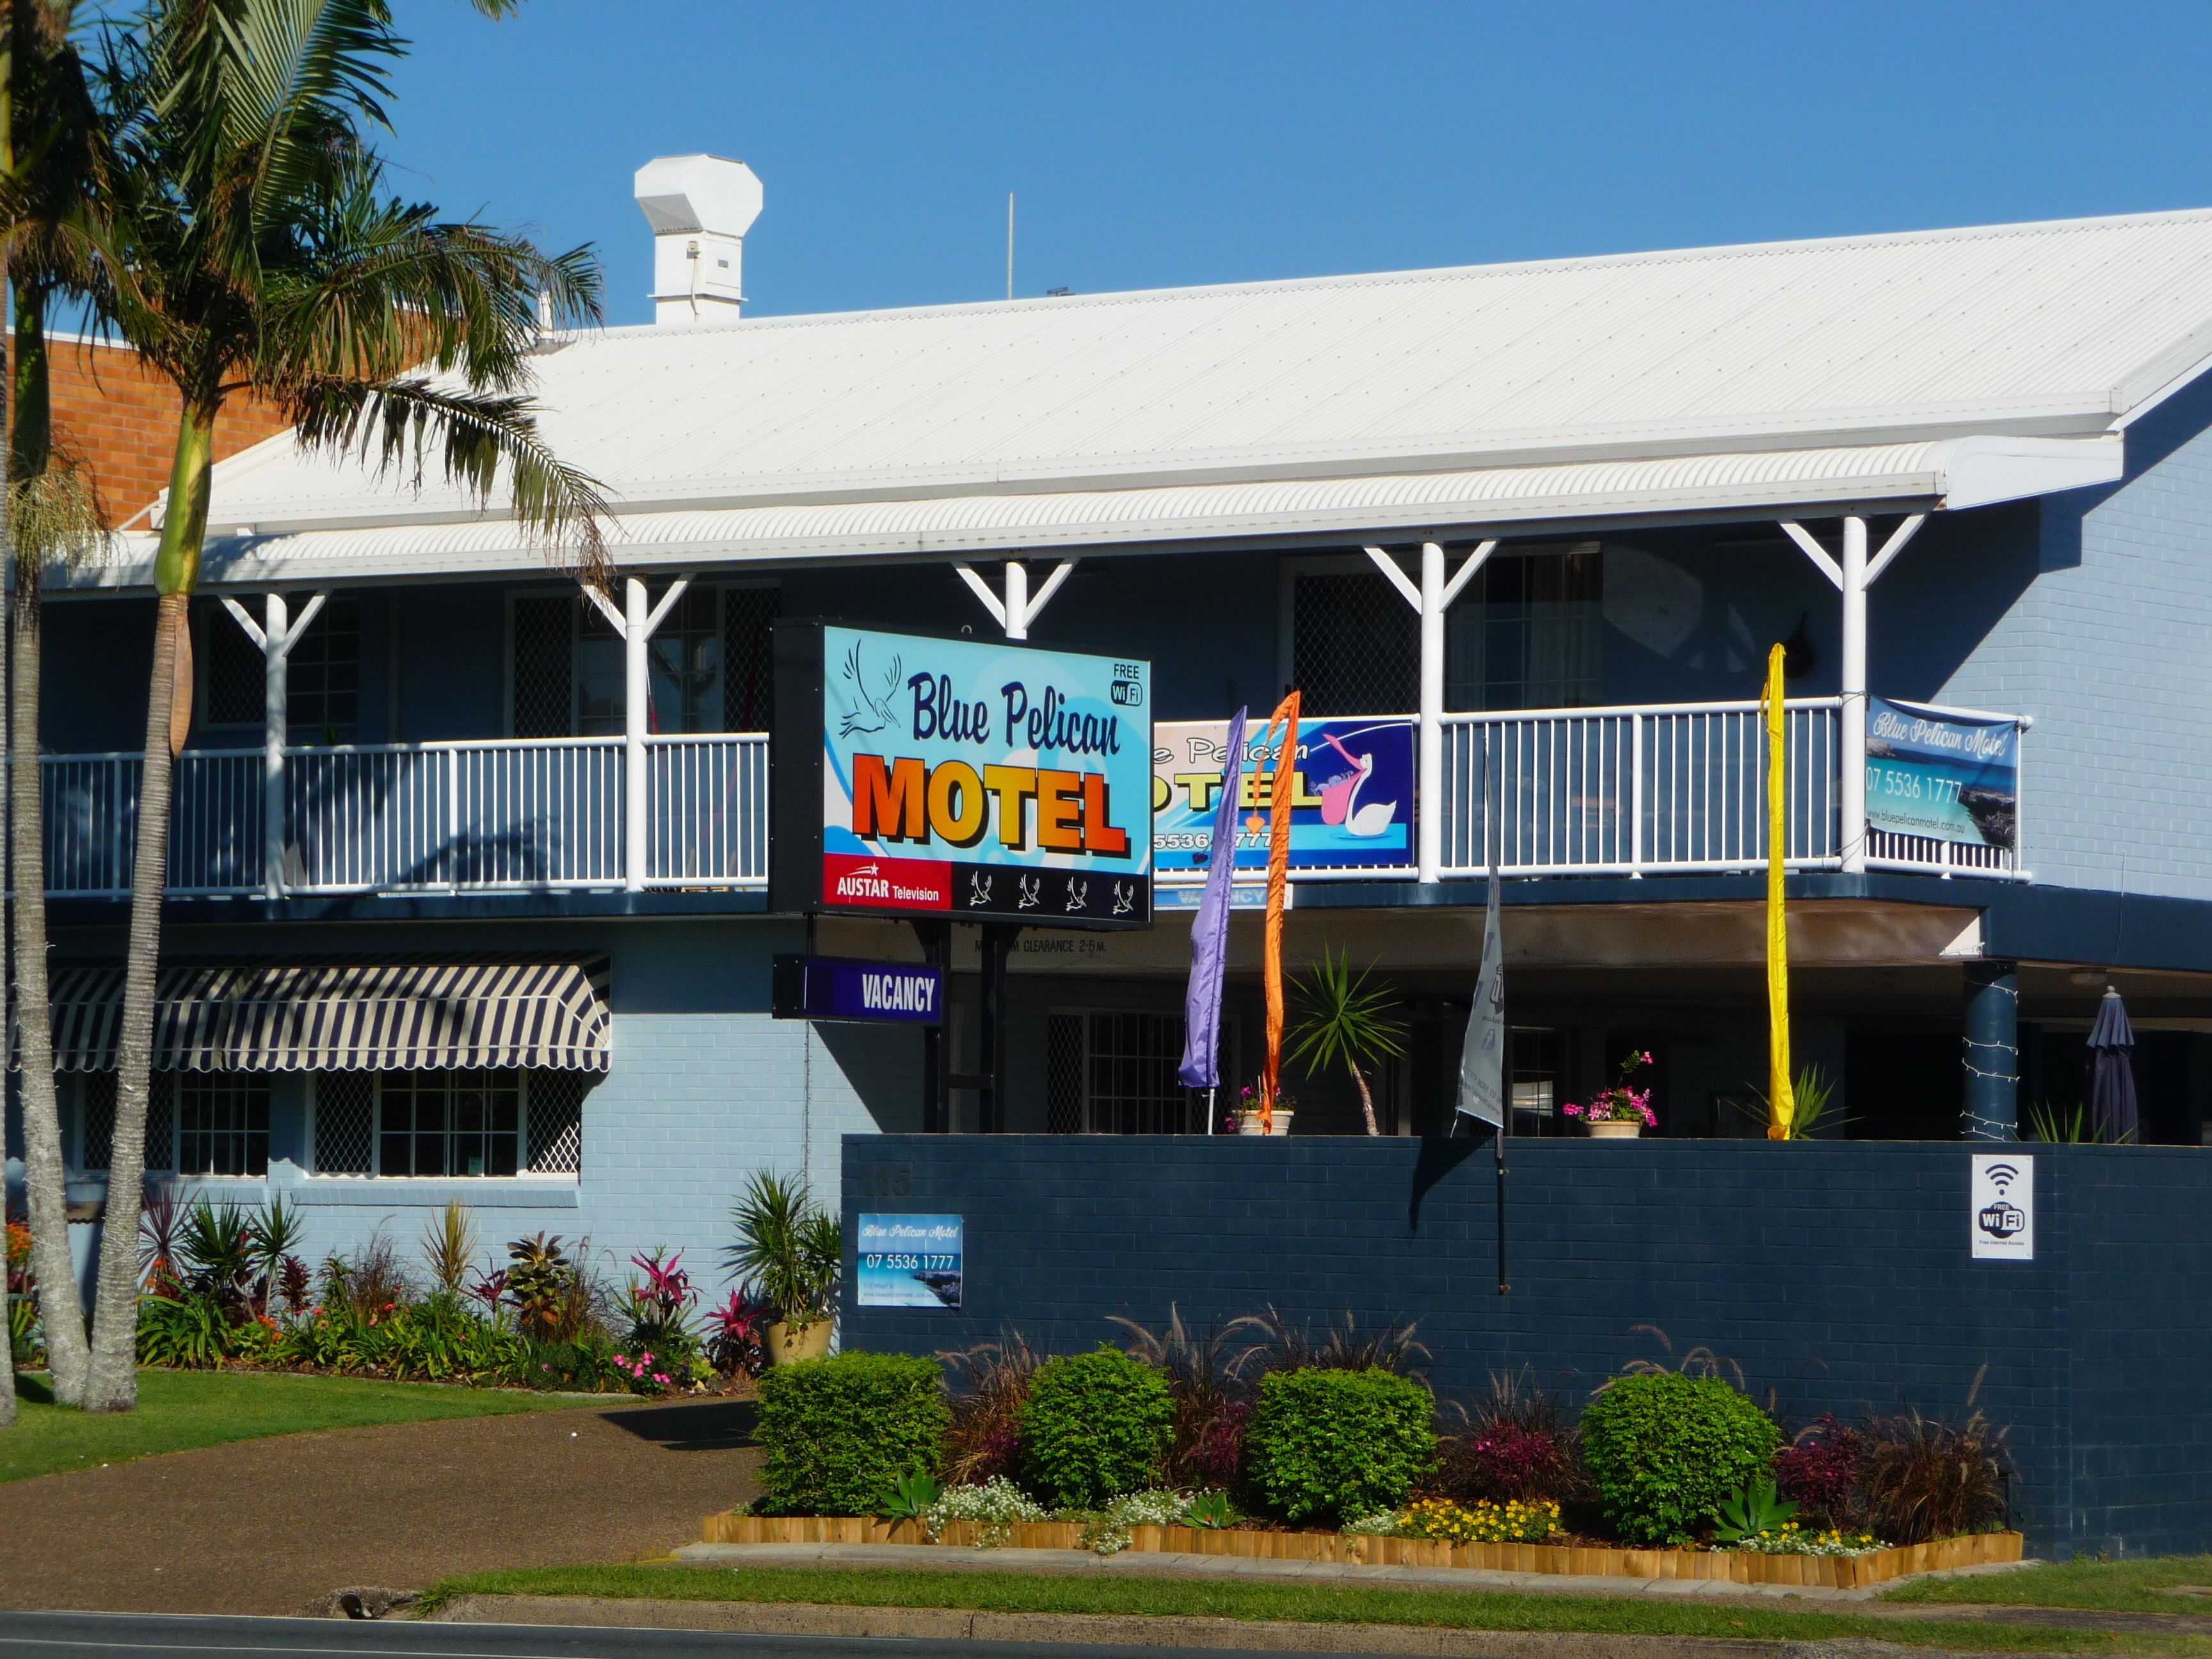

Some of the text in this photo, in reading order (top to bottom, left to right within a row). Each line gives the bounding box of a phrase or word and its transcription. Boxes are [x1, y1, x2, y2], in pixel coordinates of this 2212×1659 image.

[1114, 663, 1139, 679] FREE
[907, 671, 1121, 757] Blue Pelican
[1873, 712, 2009, 760] Blue Pelican Motel
[1187, 738, 1309, 764] Peican
[1866, 766, 1963, 804] 07 5536 1777
[852, 752, 1132, 860] MOTEL
[1866, 808, 1965, 833] www.bluepelicanmotel.com.au
[837, 876, 939, 902] AUSTAR Television
[1023, 940, 1074, 953] CLEARANCE
[862, 974, 935, 1013] VACANCY
[862, 1224, 959, 1240] Blue Pelican Motel
[867, 1254, 954, 1270] 07 5536 1777
